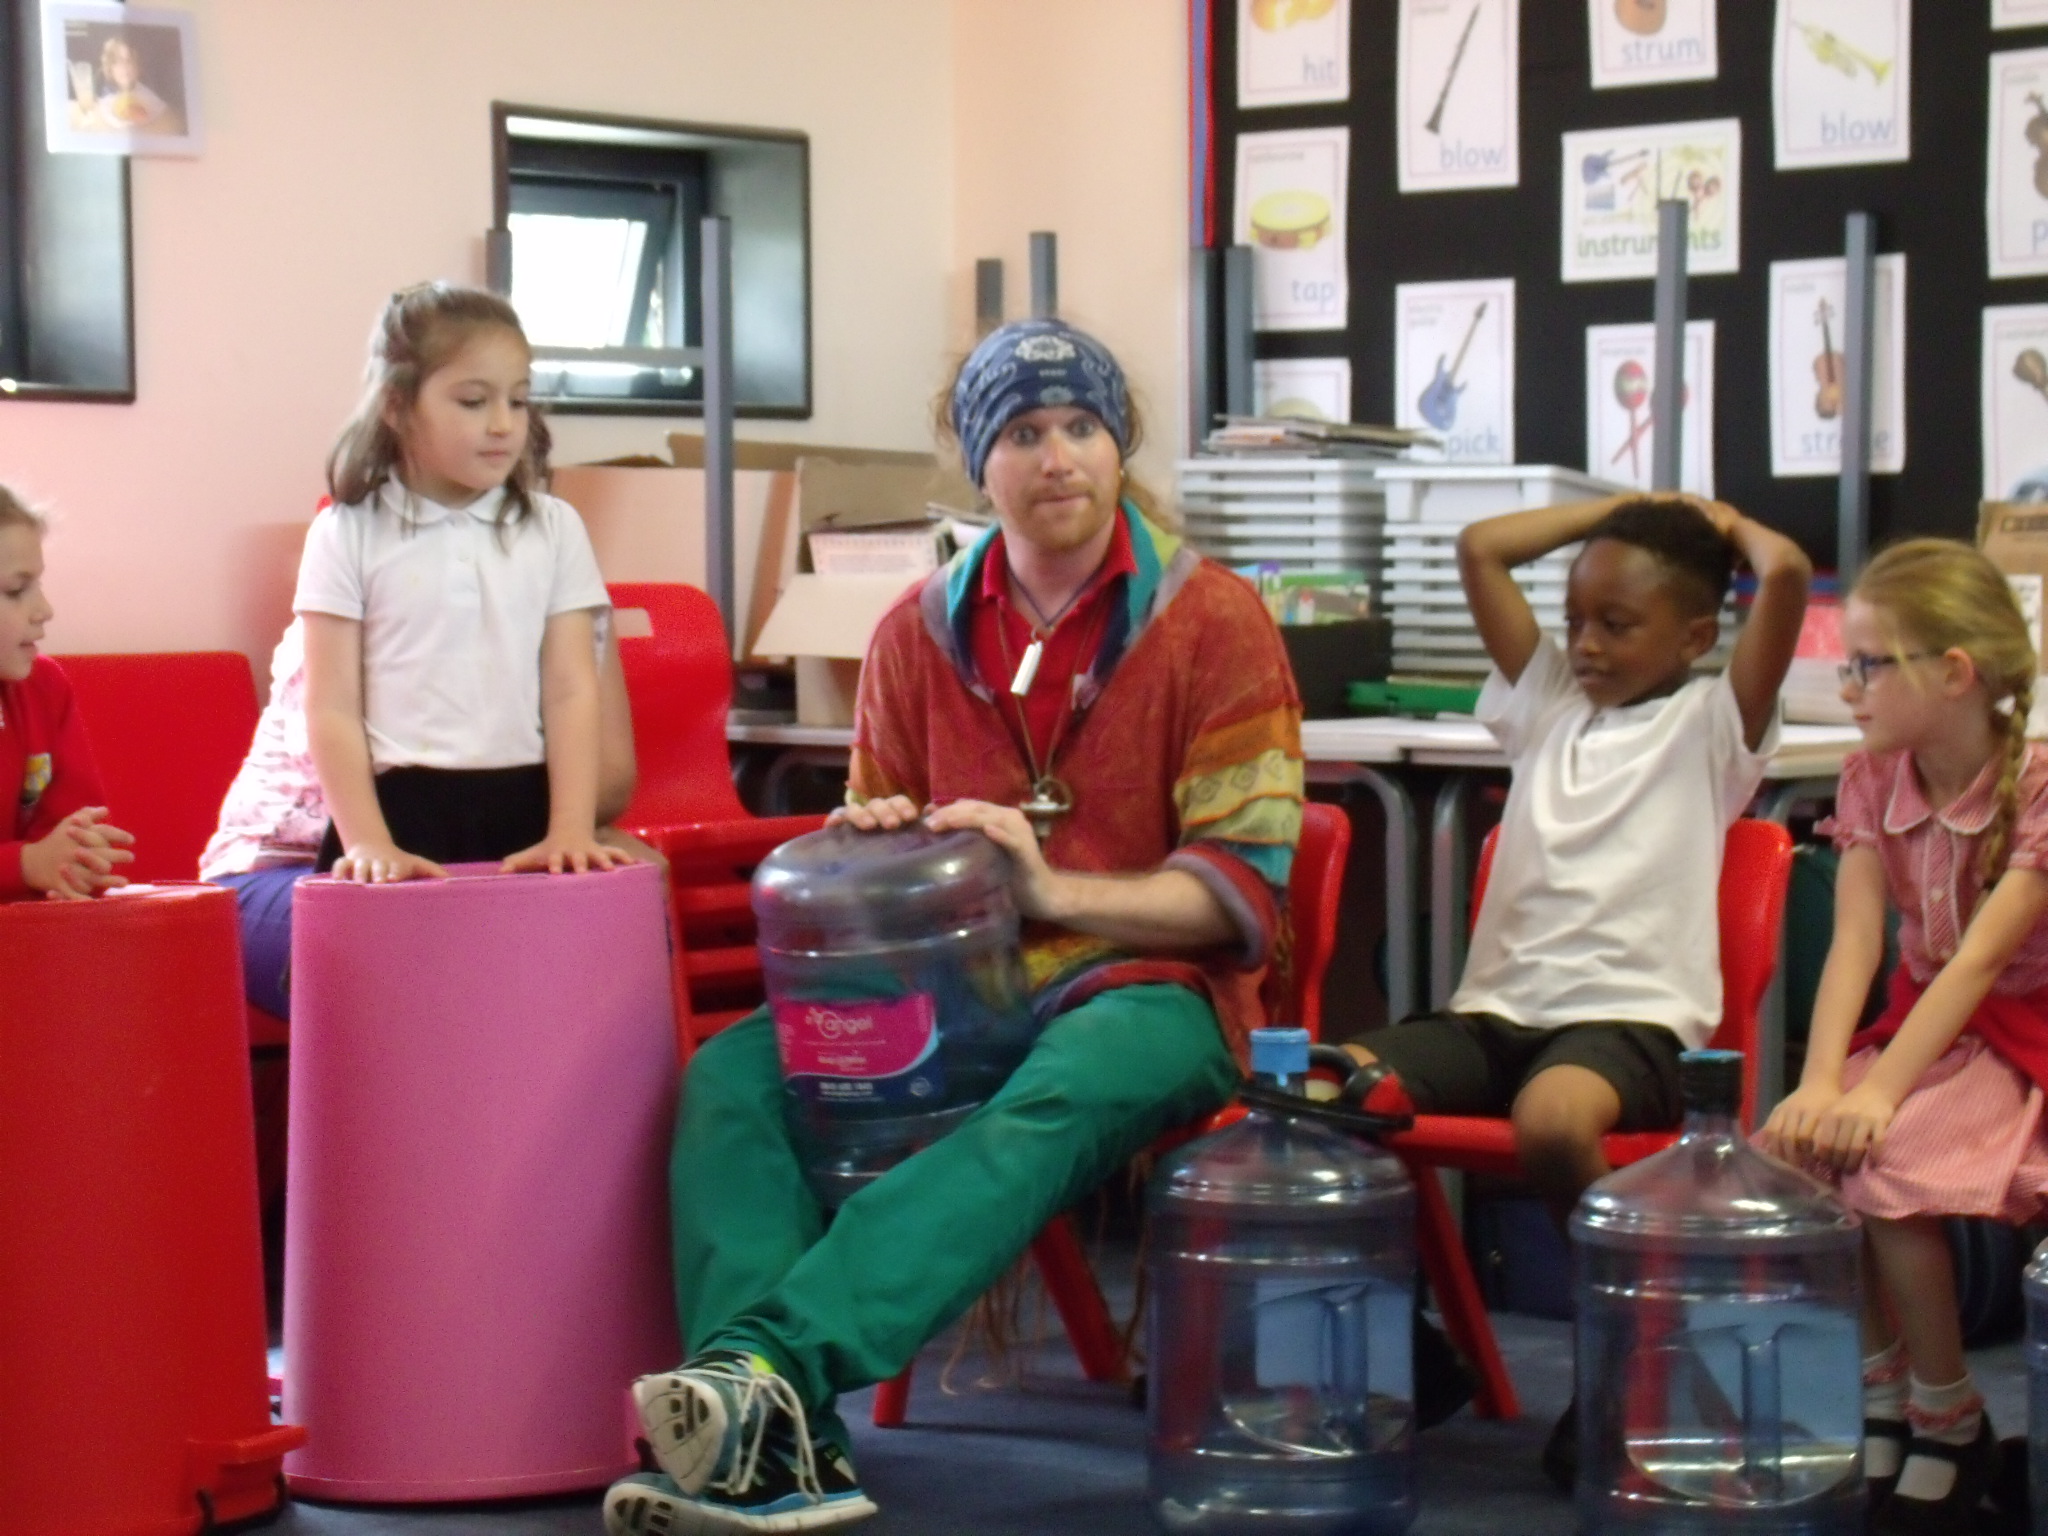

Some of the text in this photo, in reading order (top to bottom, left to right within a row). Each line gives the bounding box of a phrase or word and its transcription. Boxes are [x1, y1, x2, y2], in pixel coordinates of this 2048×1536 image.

[1621, 36, 1701, 64] strum
[1302, 55, 1336, 83] hit
[1821, 112, 1894, 144] blow
[1440, 139, 1503, 169] blow
[1577, 228, 1722, 258] instrunts
[1291, 278, 1336, 315] tap
[1448, 425, 1501, 462] pick
[1801, 429, 1890, 454] stre
